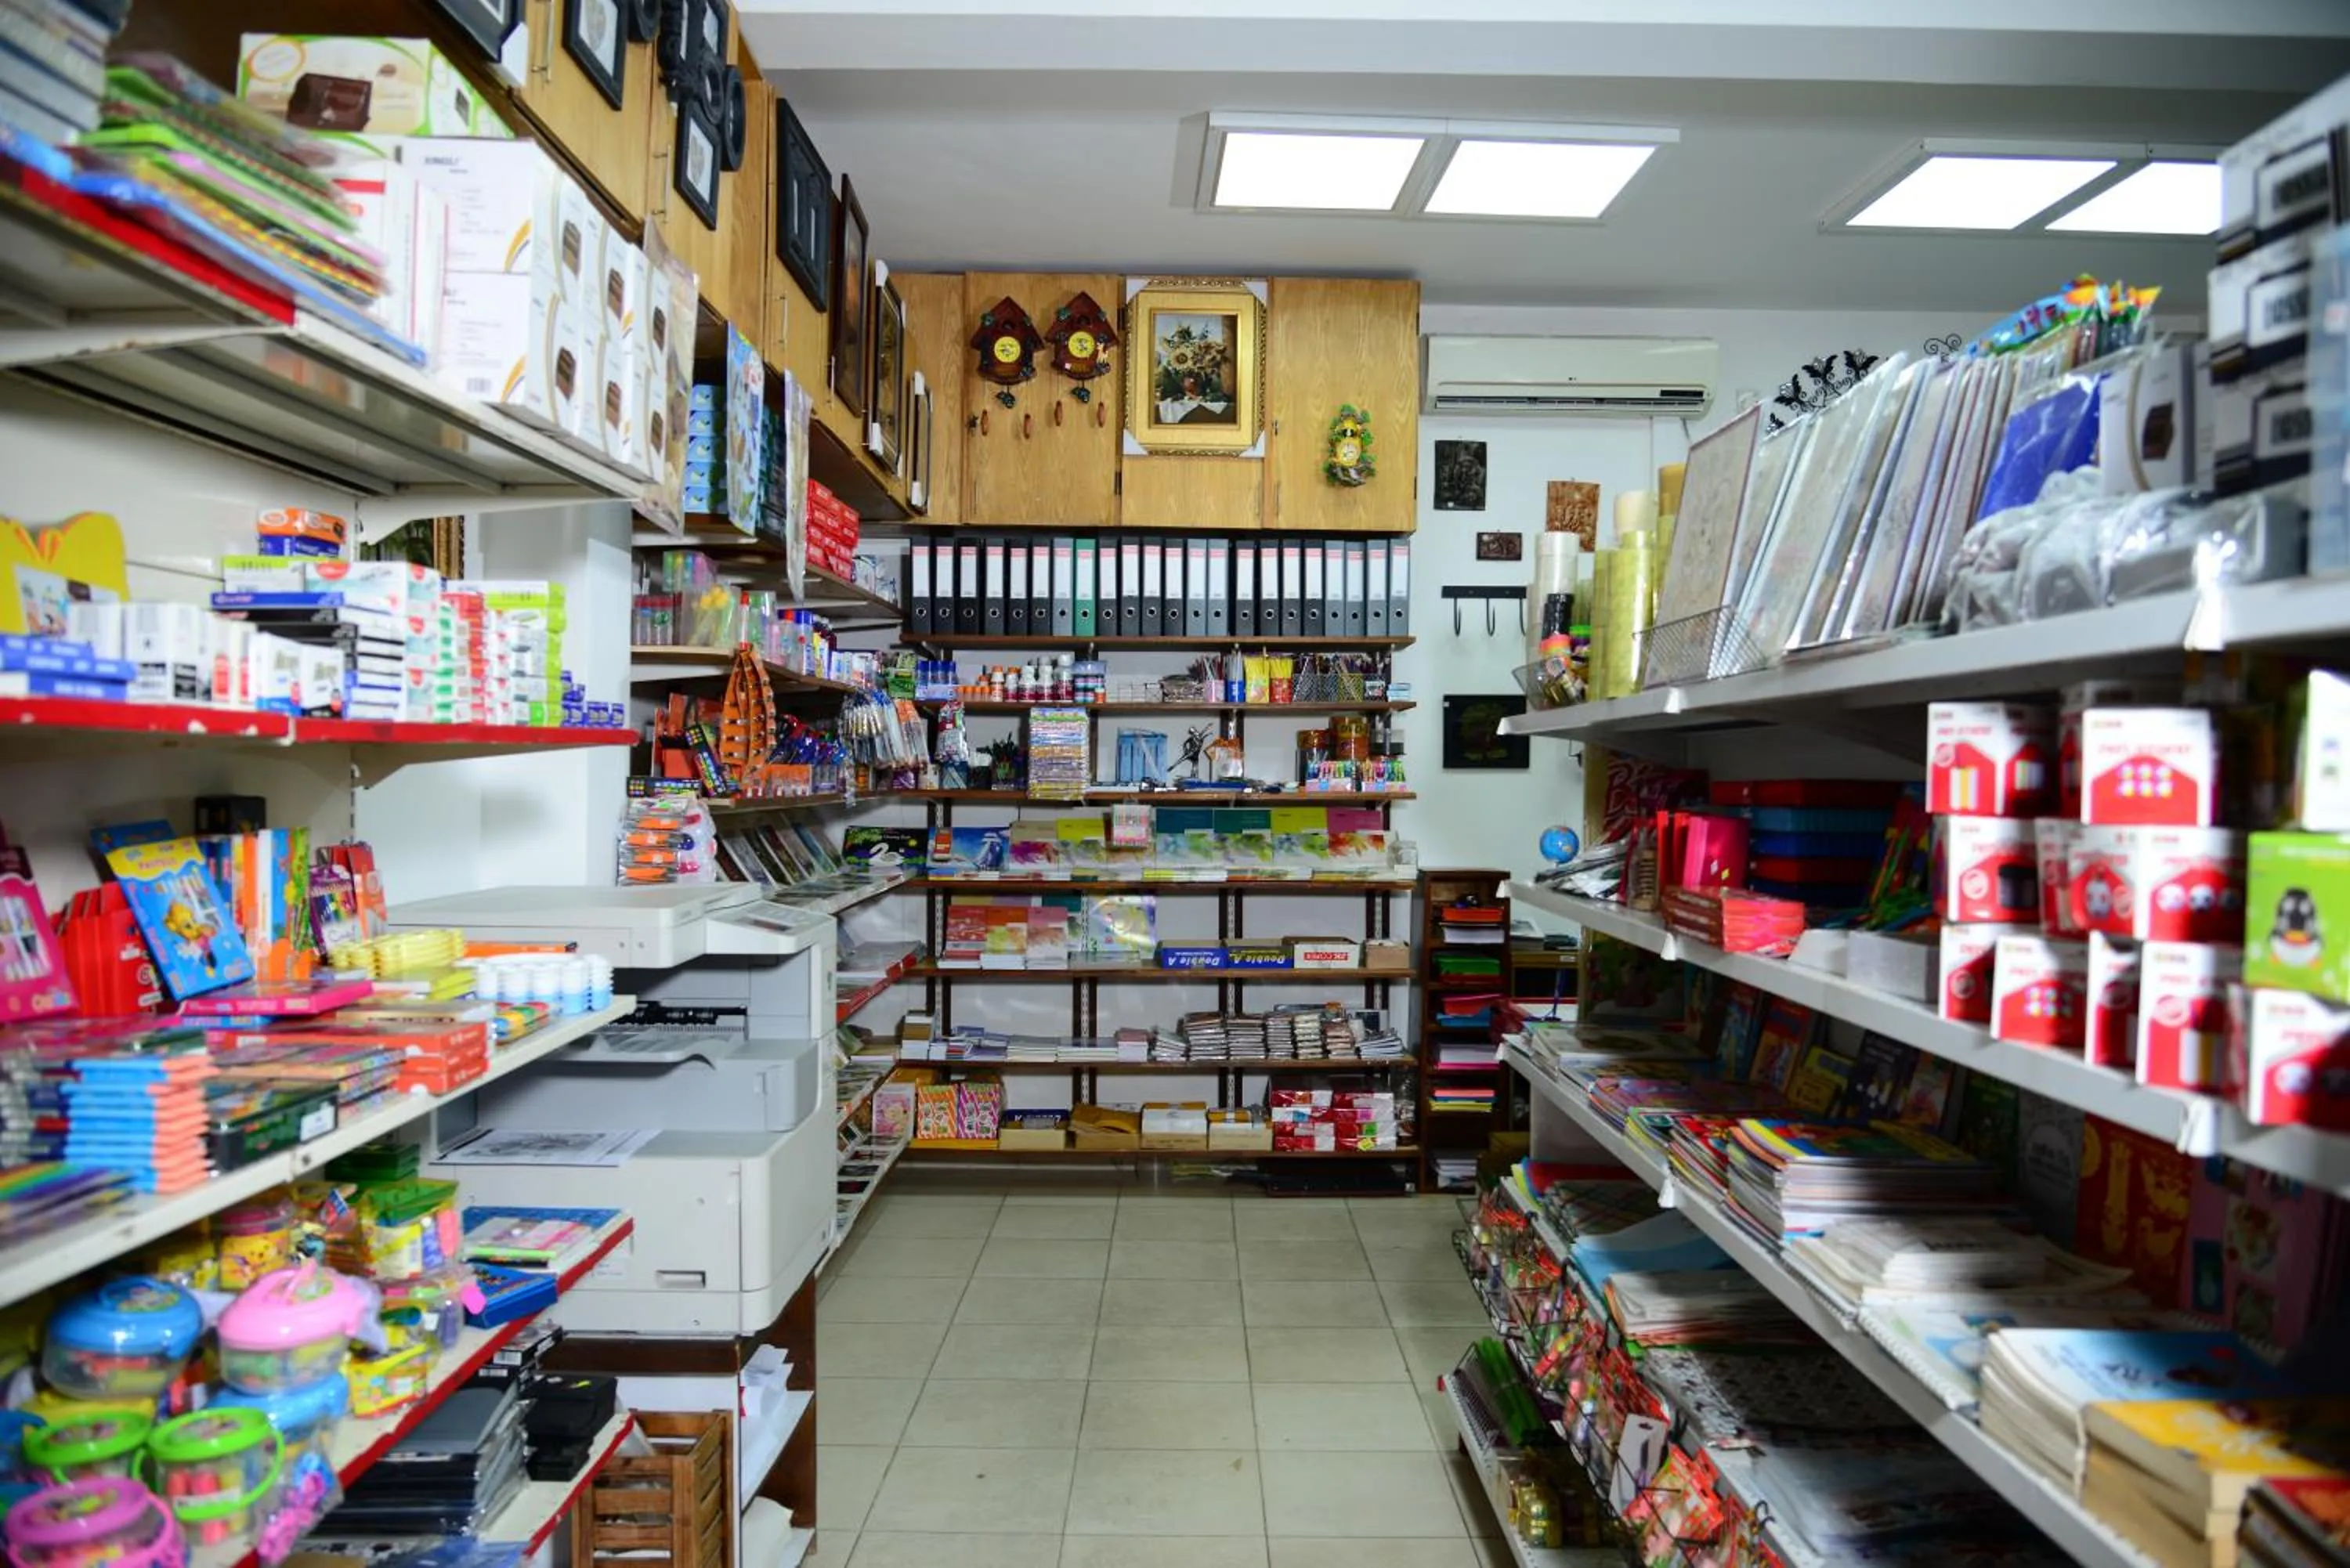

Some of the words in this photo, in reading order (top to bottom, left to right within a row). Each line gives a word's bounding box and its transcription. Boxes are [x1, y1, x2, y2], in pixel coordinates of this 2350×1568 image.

[1168, 956, 1178, 966] A
[1179, 956, 1220, 966] Double
[1230, 954, 1240, 964] A
[1245, 953, 1285, 964] Double
